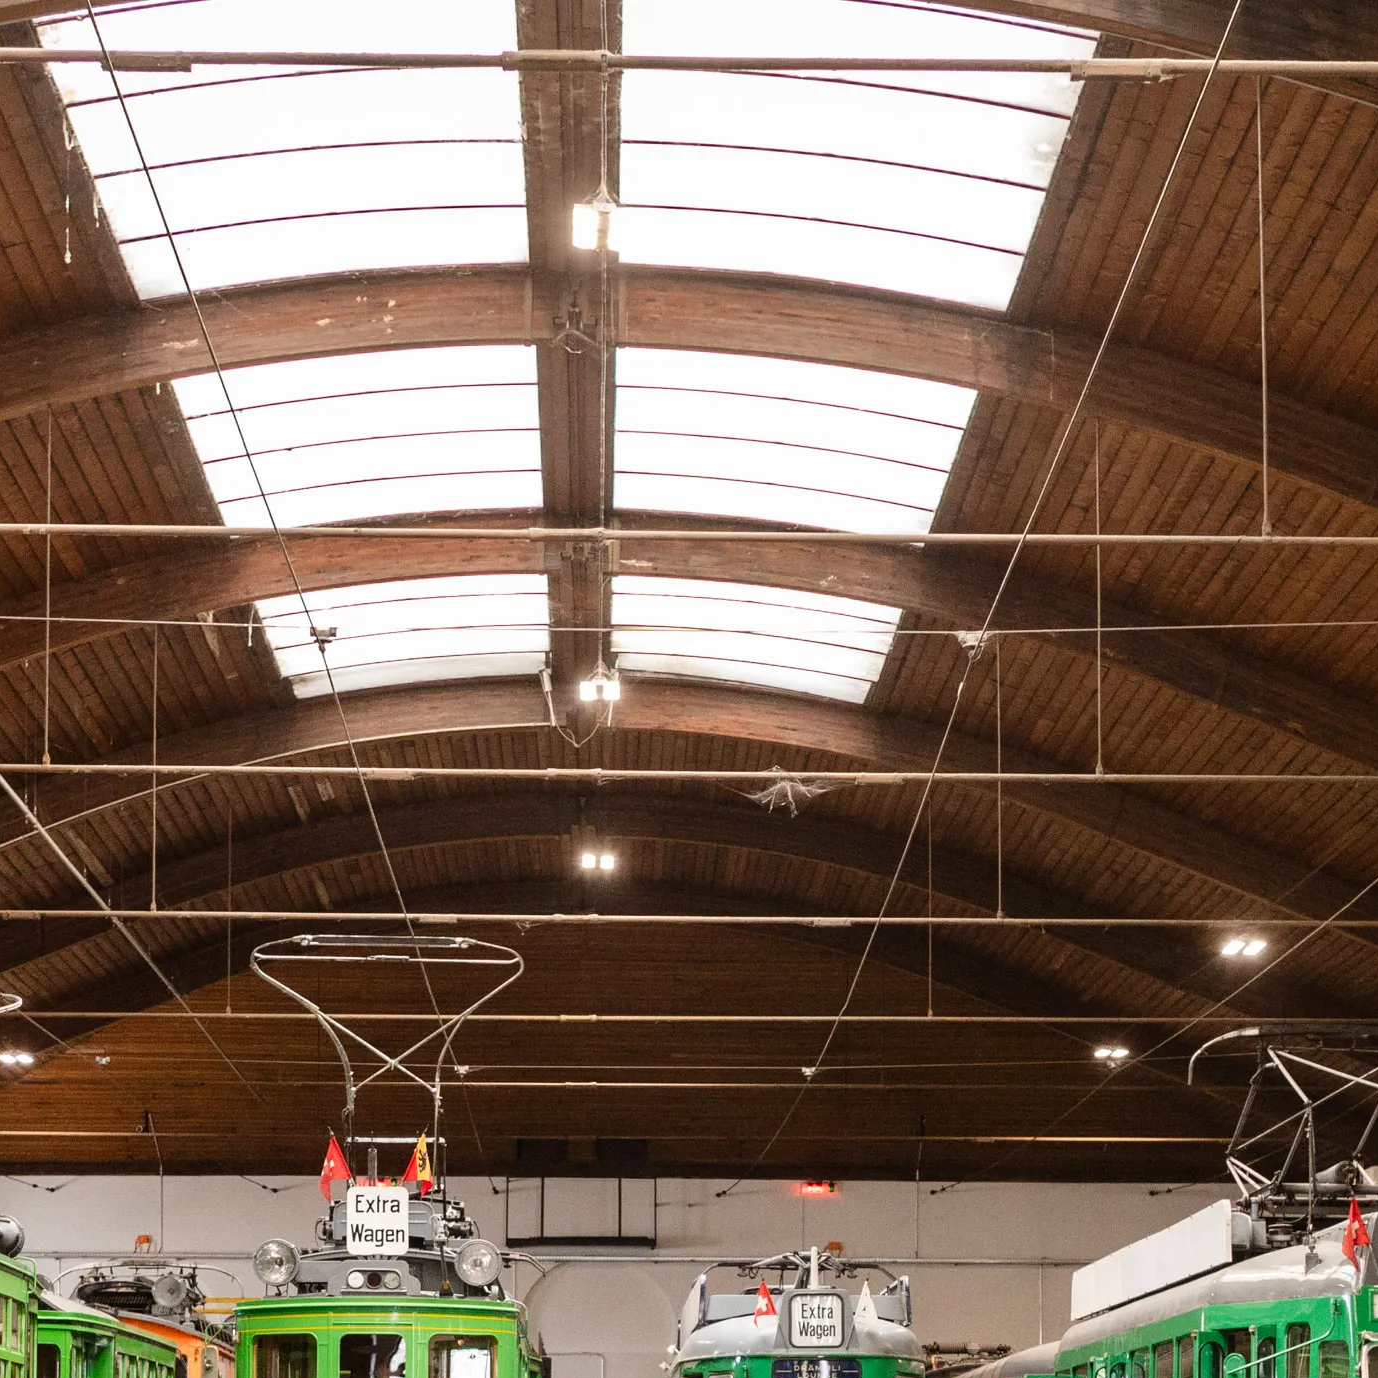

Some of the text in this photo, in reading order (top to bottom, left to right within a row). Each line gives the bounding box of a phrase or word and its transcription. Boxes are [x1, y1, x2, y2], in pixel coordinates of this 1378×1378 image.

[355, 1194, 400, 1213] Extra
[350, 1223, 405, 1247] Wagen
[801, 1303, 834, 1319] Extra
[798, 1321, 836, 1340] Wagen
